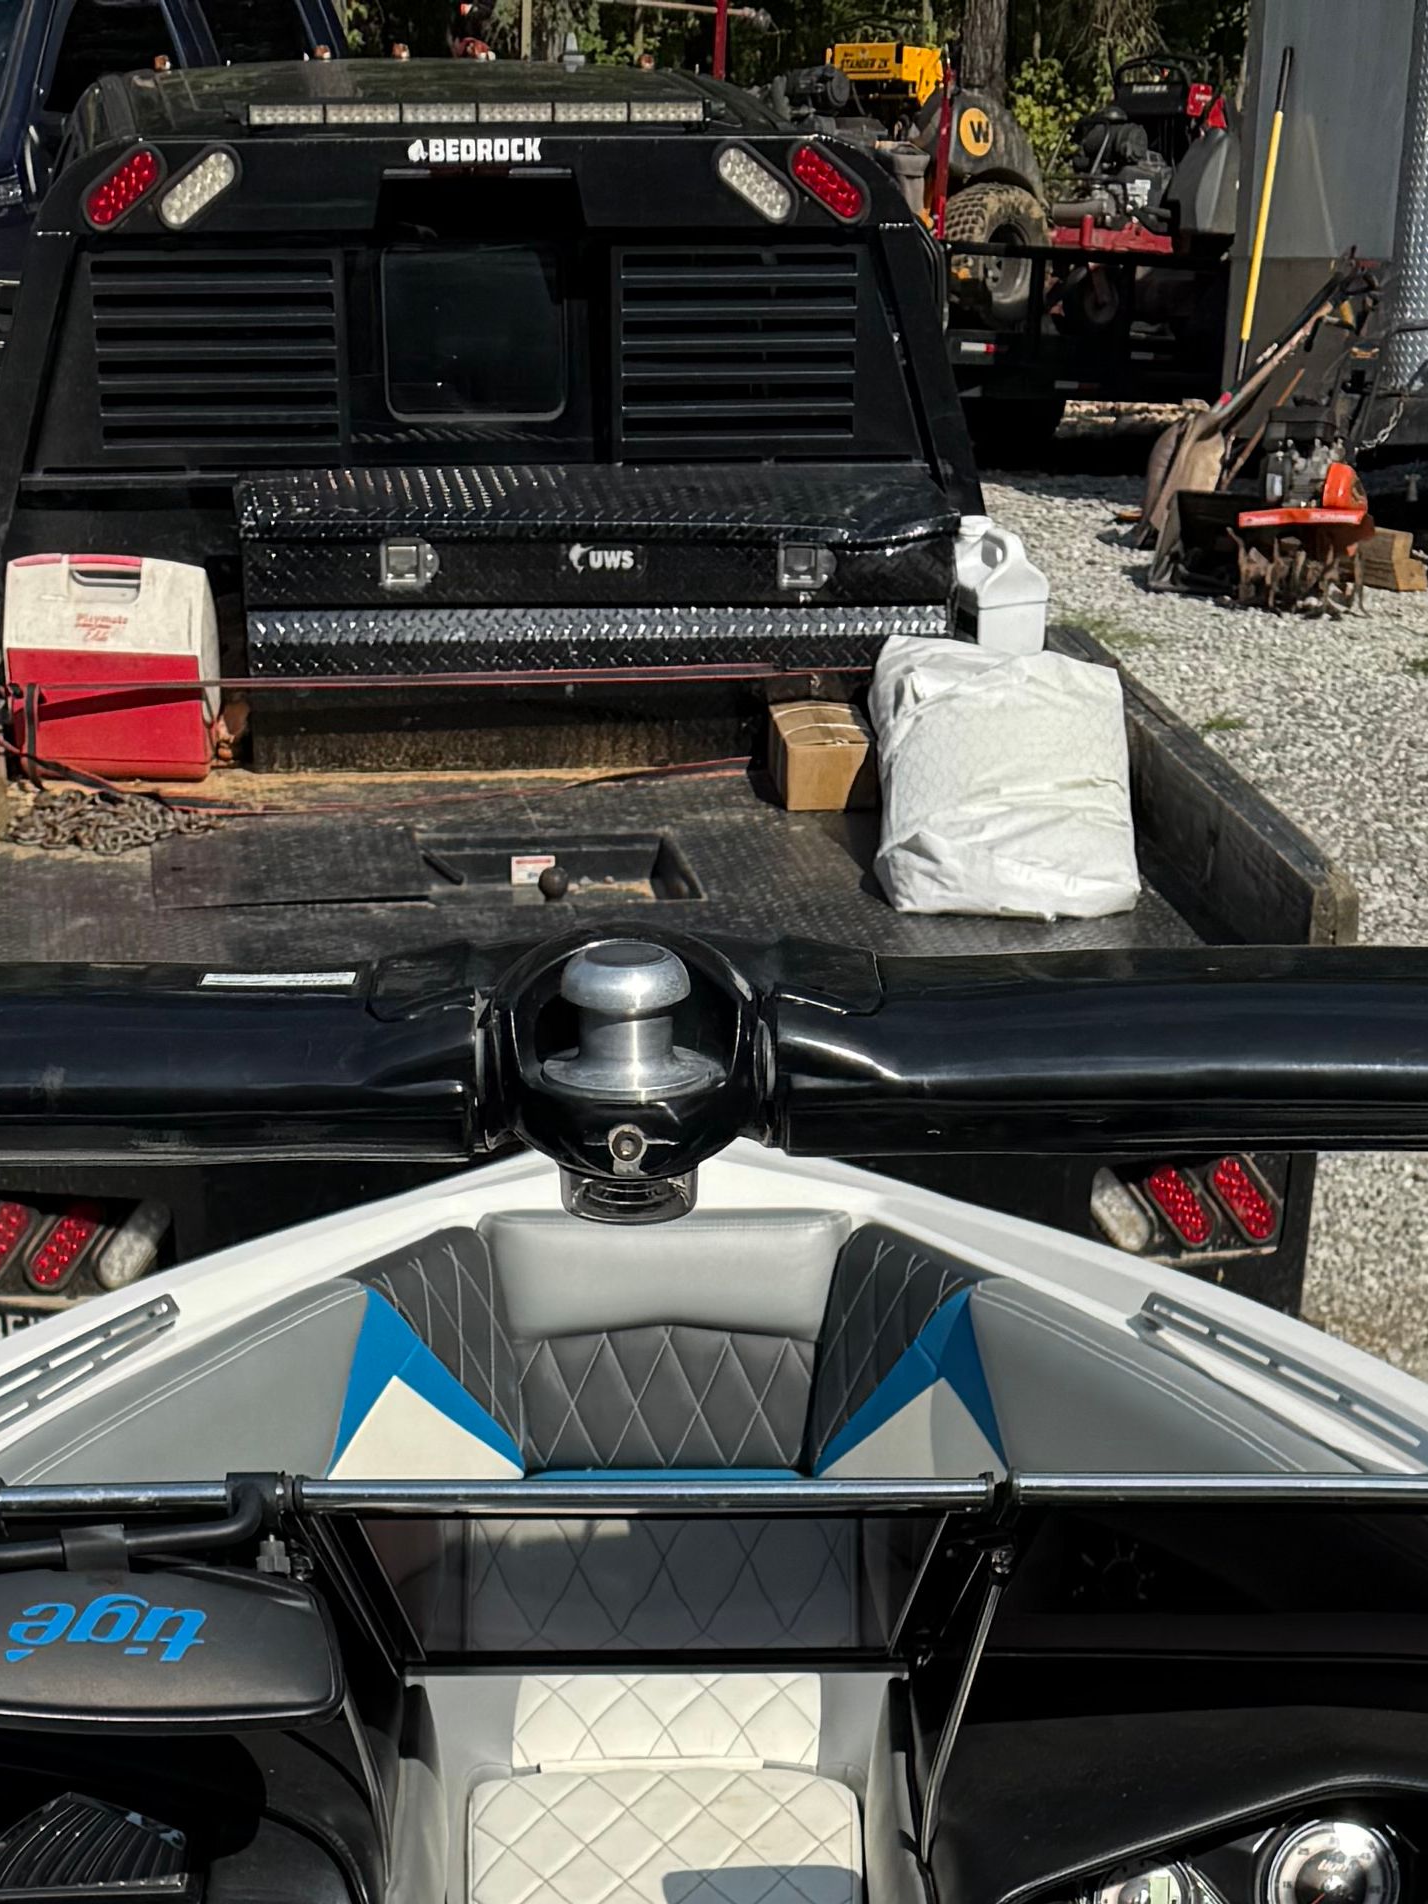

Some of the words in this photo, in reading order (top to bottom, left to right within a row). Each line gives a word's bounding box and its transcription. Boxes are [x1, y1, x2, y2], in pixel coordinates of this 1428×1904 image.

[969, 119, 991, 144] W
[428, 137, 542, 163] BEDROCK
[589, 550, 635, 570] UWS
